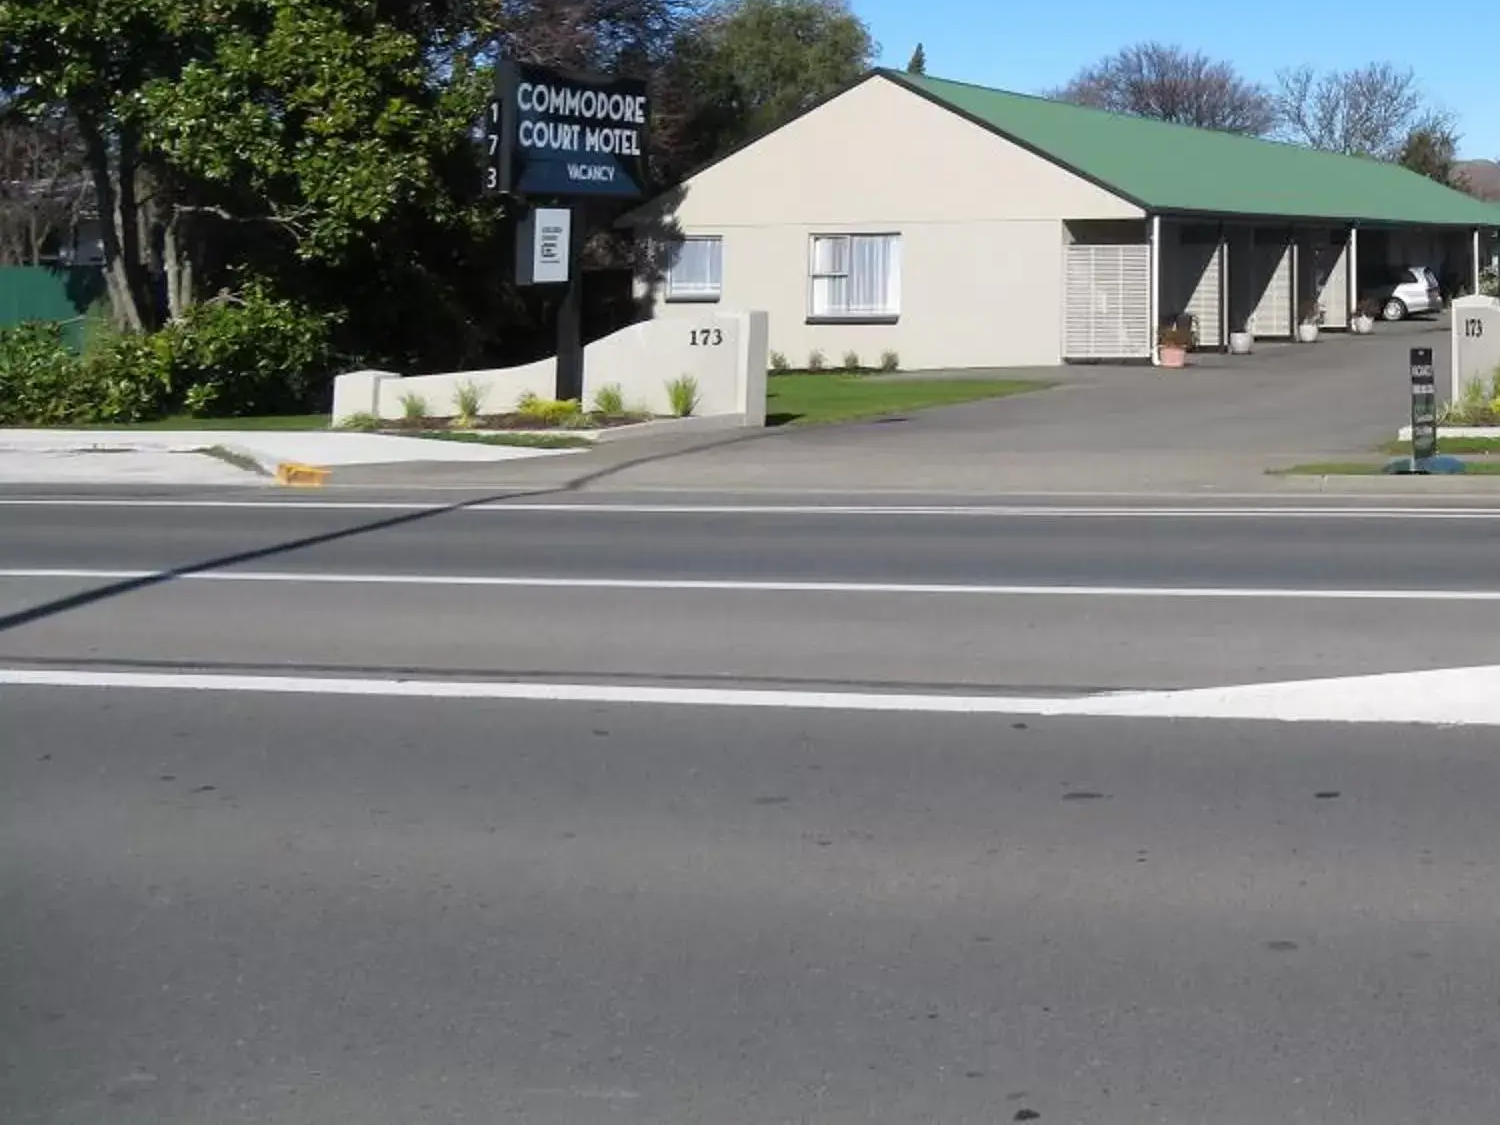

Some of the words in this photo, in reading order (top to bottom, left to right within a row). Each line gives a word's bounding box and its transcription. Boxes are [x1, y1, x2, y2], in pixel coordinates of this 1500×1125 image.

[517, 82, 646, 124] COMMODORE
[519, 120, 580, 151] COURT
[585, 126, 641, 156] MOTEL
[567, 163, 615, 182] VACANCY
[690, 328, 723, 346] 173
[1465, 318, 1483, 337] 173
